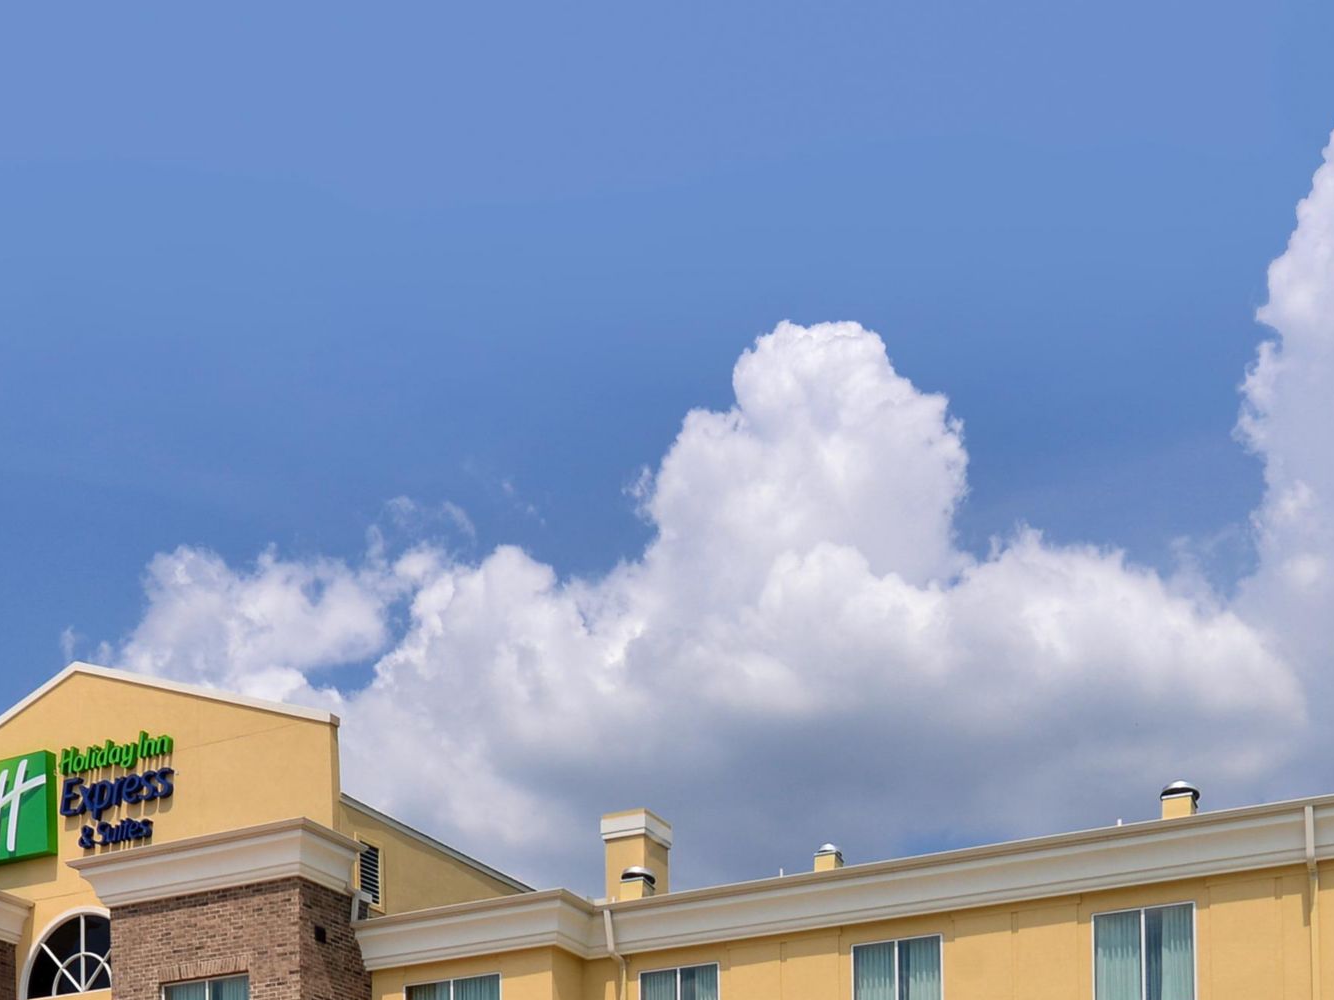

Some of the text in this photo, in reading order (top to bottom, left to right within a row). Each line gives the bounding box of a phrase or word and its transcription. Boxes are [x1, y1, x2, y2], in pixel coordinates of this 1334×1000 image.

[60, 730, 174, 776] Holiday Inn
[60, 767, 175, 821] Express
[78, 818, 154, 849] & Suites
